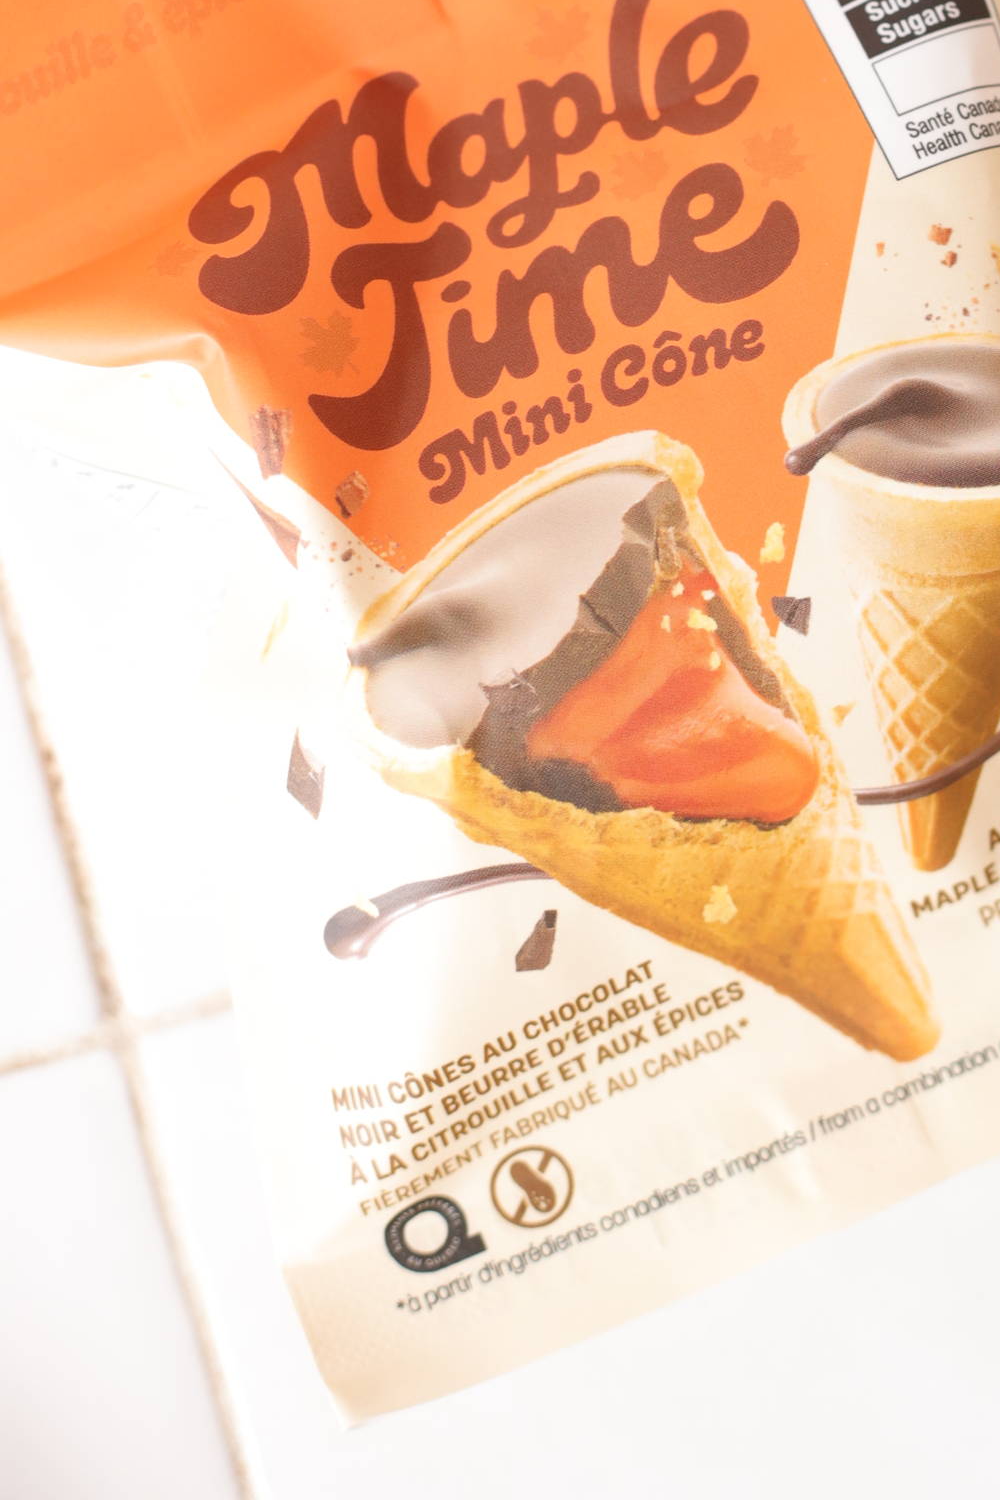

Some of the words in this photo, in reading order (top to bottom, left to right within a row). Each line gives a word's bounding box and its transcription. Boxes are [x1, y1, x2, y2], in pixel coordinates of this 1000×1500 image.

[122, 2, 157, 52] &
[876, 0, 960, 45] Sugars
[905, 108, 955, 139] Santé
[912, 129, 967, 160] Health
[307, 162, 800, 451] Time
[418, 368, 593, 505] Mini
[600, 319, 766, 407] Cône
[911, 863, 1000, 918] MAPLE
[331, 1084, 383, 1112] MINI
[387, 1055, 476, 1104] CÔNES
[482, 1031, 517, 1063] AU
[523, 960, 654, 1040] CHOCOLAT
[350, 1155, 368, 1186] À
[371, 1154, 407, 1180] LA
[411, 1072, 554, 1162] CITROUILLE
[558, 1053, 587, 1082] ET
[597, 1026, 650, 1065] AUX
[653, 981, 745, 1037] ÉPICES
[339, 1119, 400, 1149] NOIR
[404, 1105, 435, 1134] ET
[441, 1049, 542, 1116] BEURRE
[359, 1143, 483, 1216] FIÈREMENT
[489, 1083, 601, 1149] FABRIQUÉ
[608, 1068, 638, 1096] AU
[424, 1273, 474, 1310] partir
[600, 1176, 701, 1231] canadiens
[702, 1165, 723, 1188] et
[725, 1127, 805, 1177] importés
[818, 1104, 866, 1137] from
[866, 1097, 882, 1115] a
[882, 1043, 999, 1108] combination
